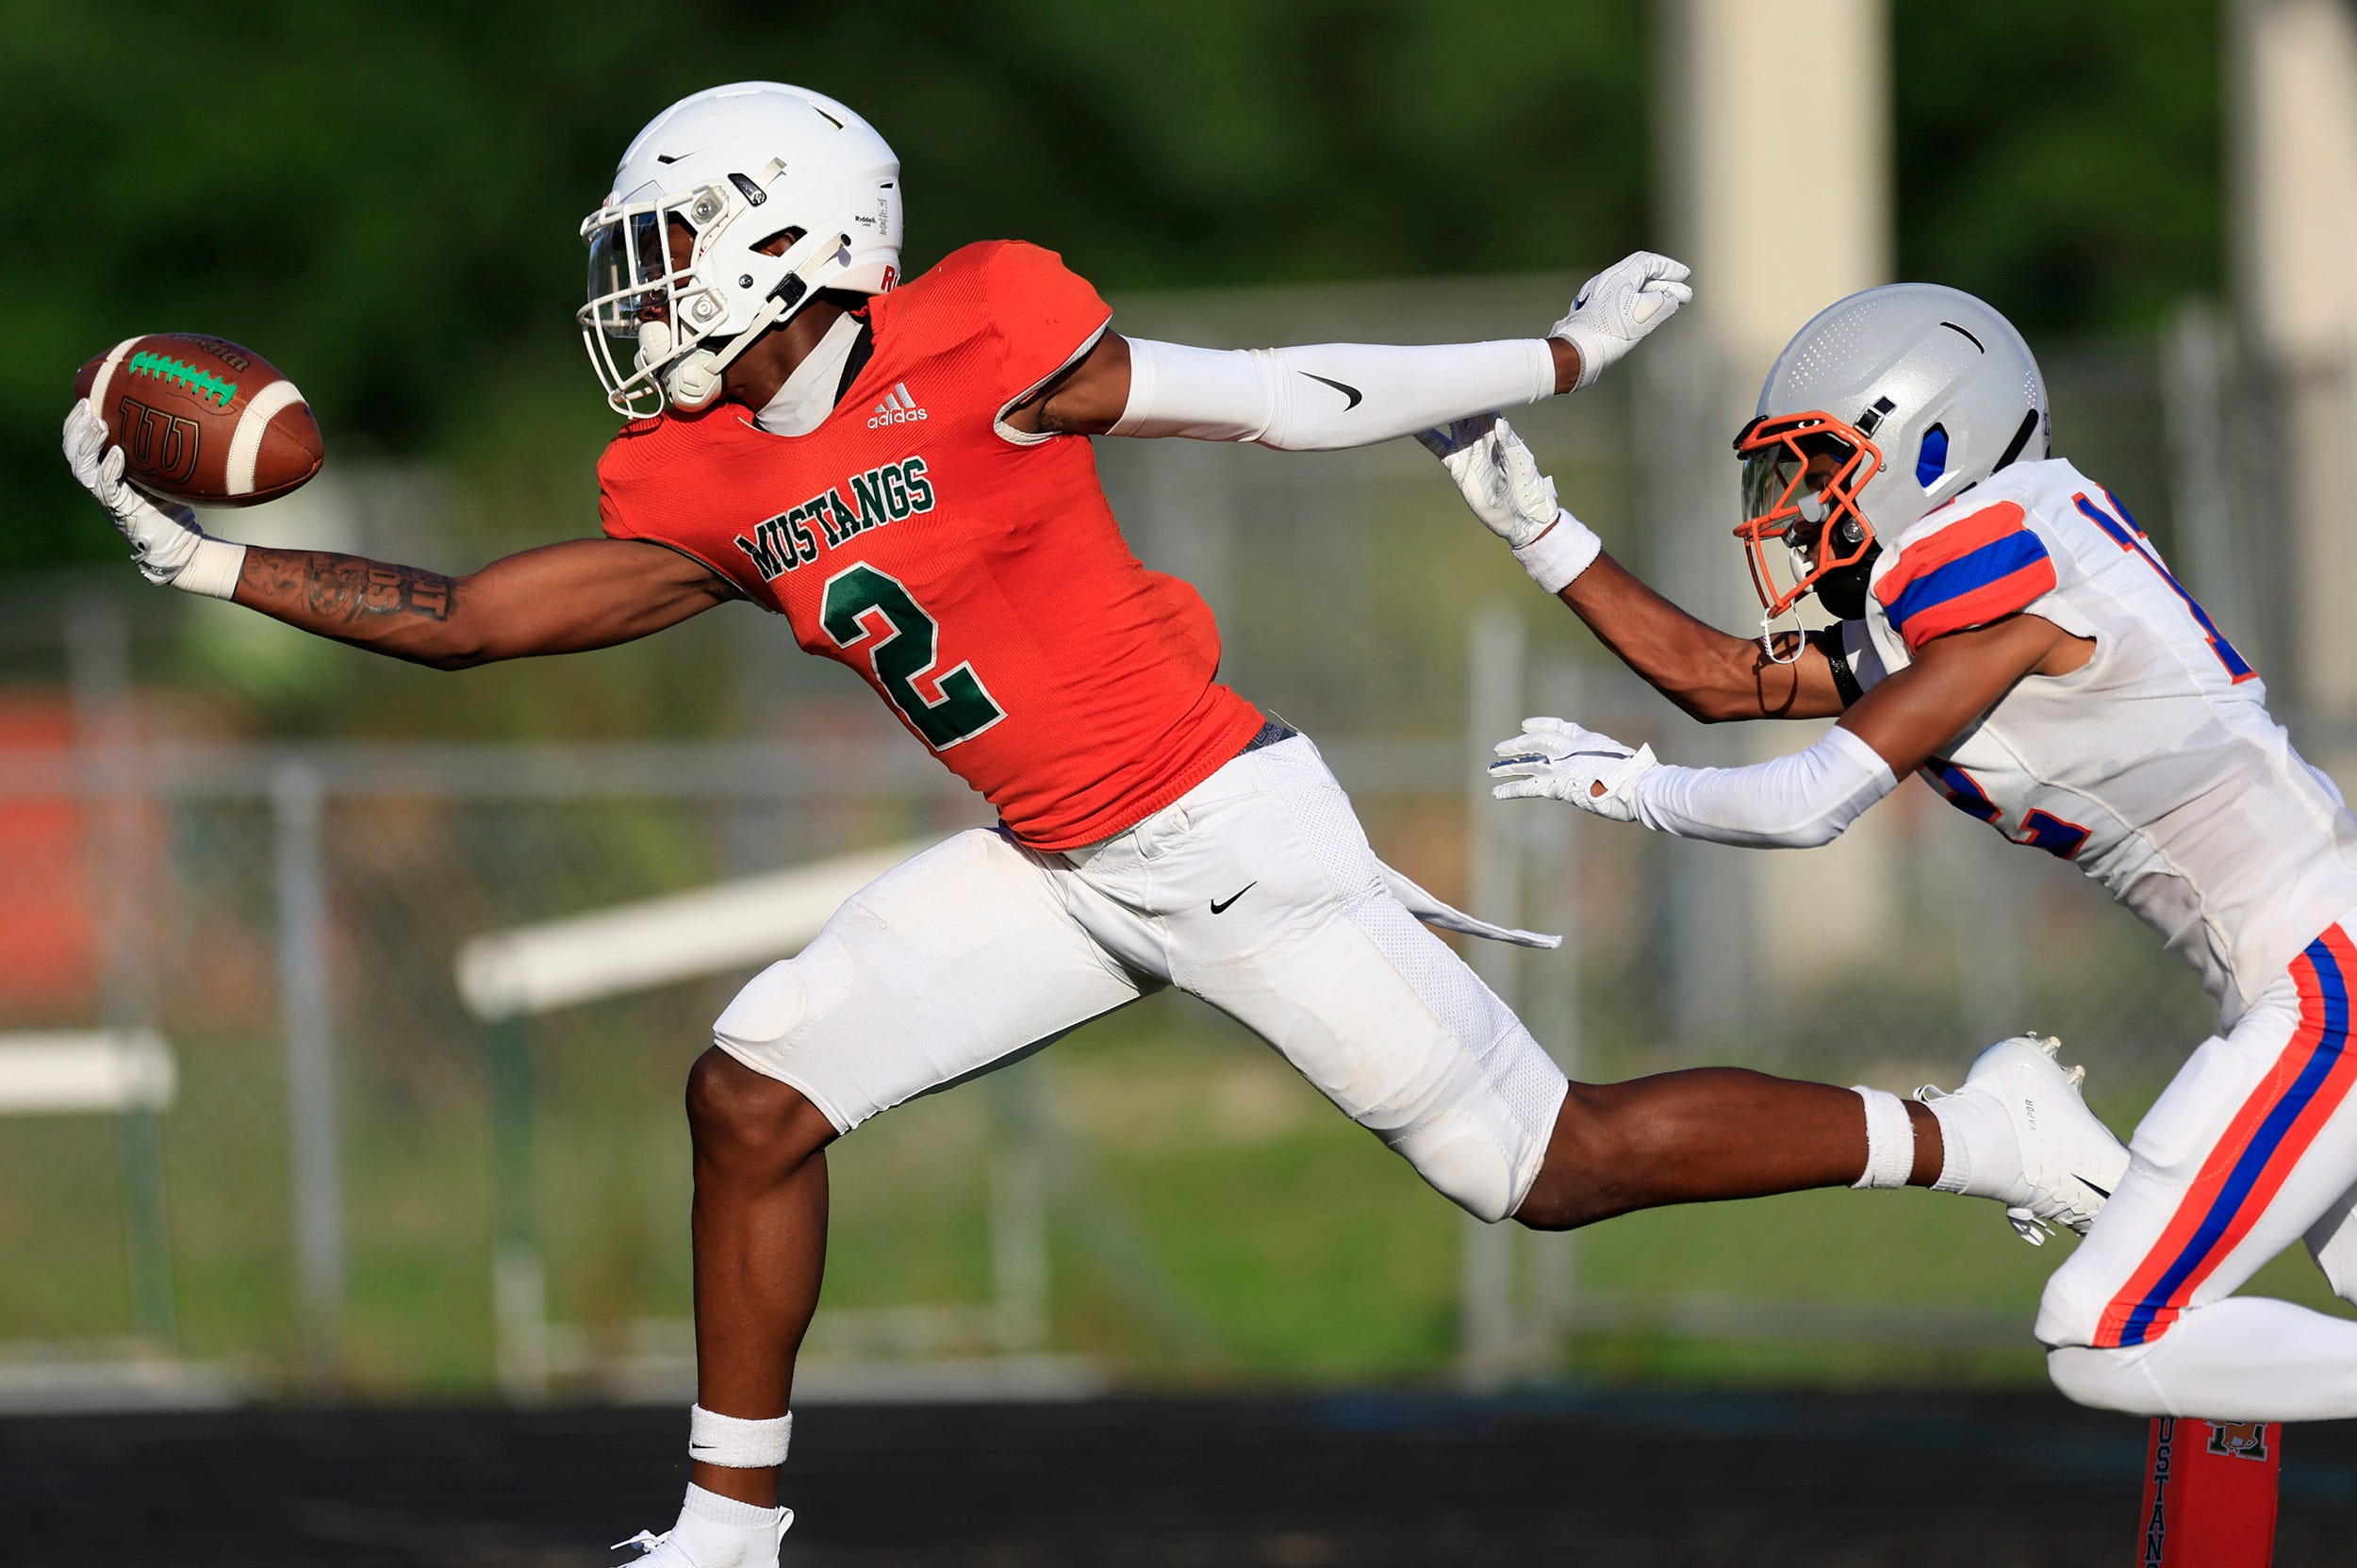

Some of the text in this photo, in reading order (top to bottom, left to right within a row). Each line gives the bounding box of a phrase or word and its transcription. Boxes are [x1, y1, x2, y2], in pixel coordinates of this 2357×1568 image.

[867, 404, 928, 430] adidas
[733, 454, 936, 583] MUSTANGS
[149, 566, 164, 575] XL
[819, 560, 1009, 752] 2
[2024, 1098, 2036, 1131] VAPOR
